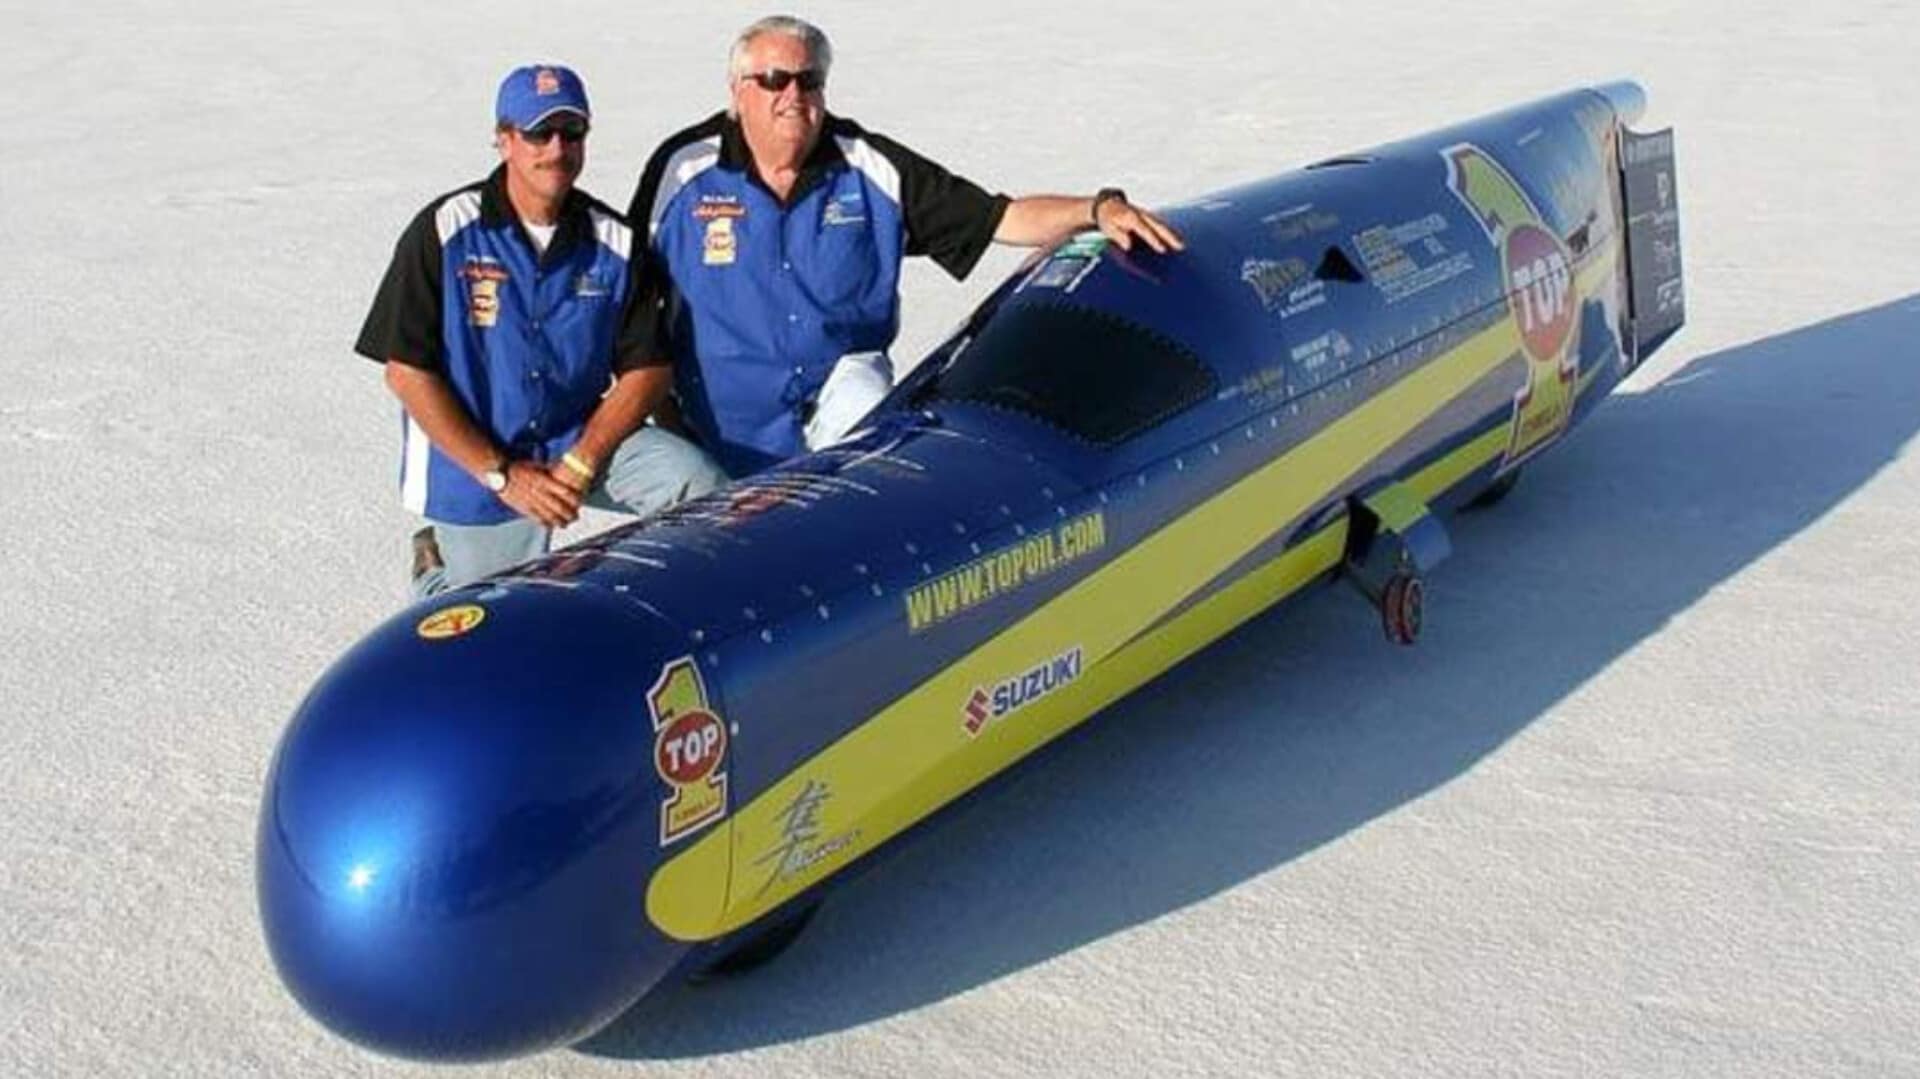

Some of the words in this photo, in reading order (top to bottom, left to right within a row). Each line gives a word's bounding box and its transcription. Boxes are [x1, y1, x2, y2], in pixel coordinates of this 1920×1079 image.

[1512, 252, 1570, 333] TOP
[907, 513, 1105, 629] WWW.TOPOIL.COM
[992, 648, 1081, 716] SUZUKI
[666, 723, 719, 771] TOP
